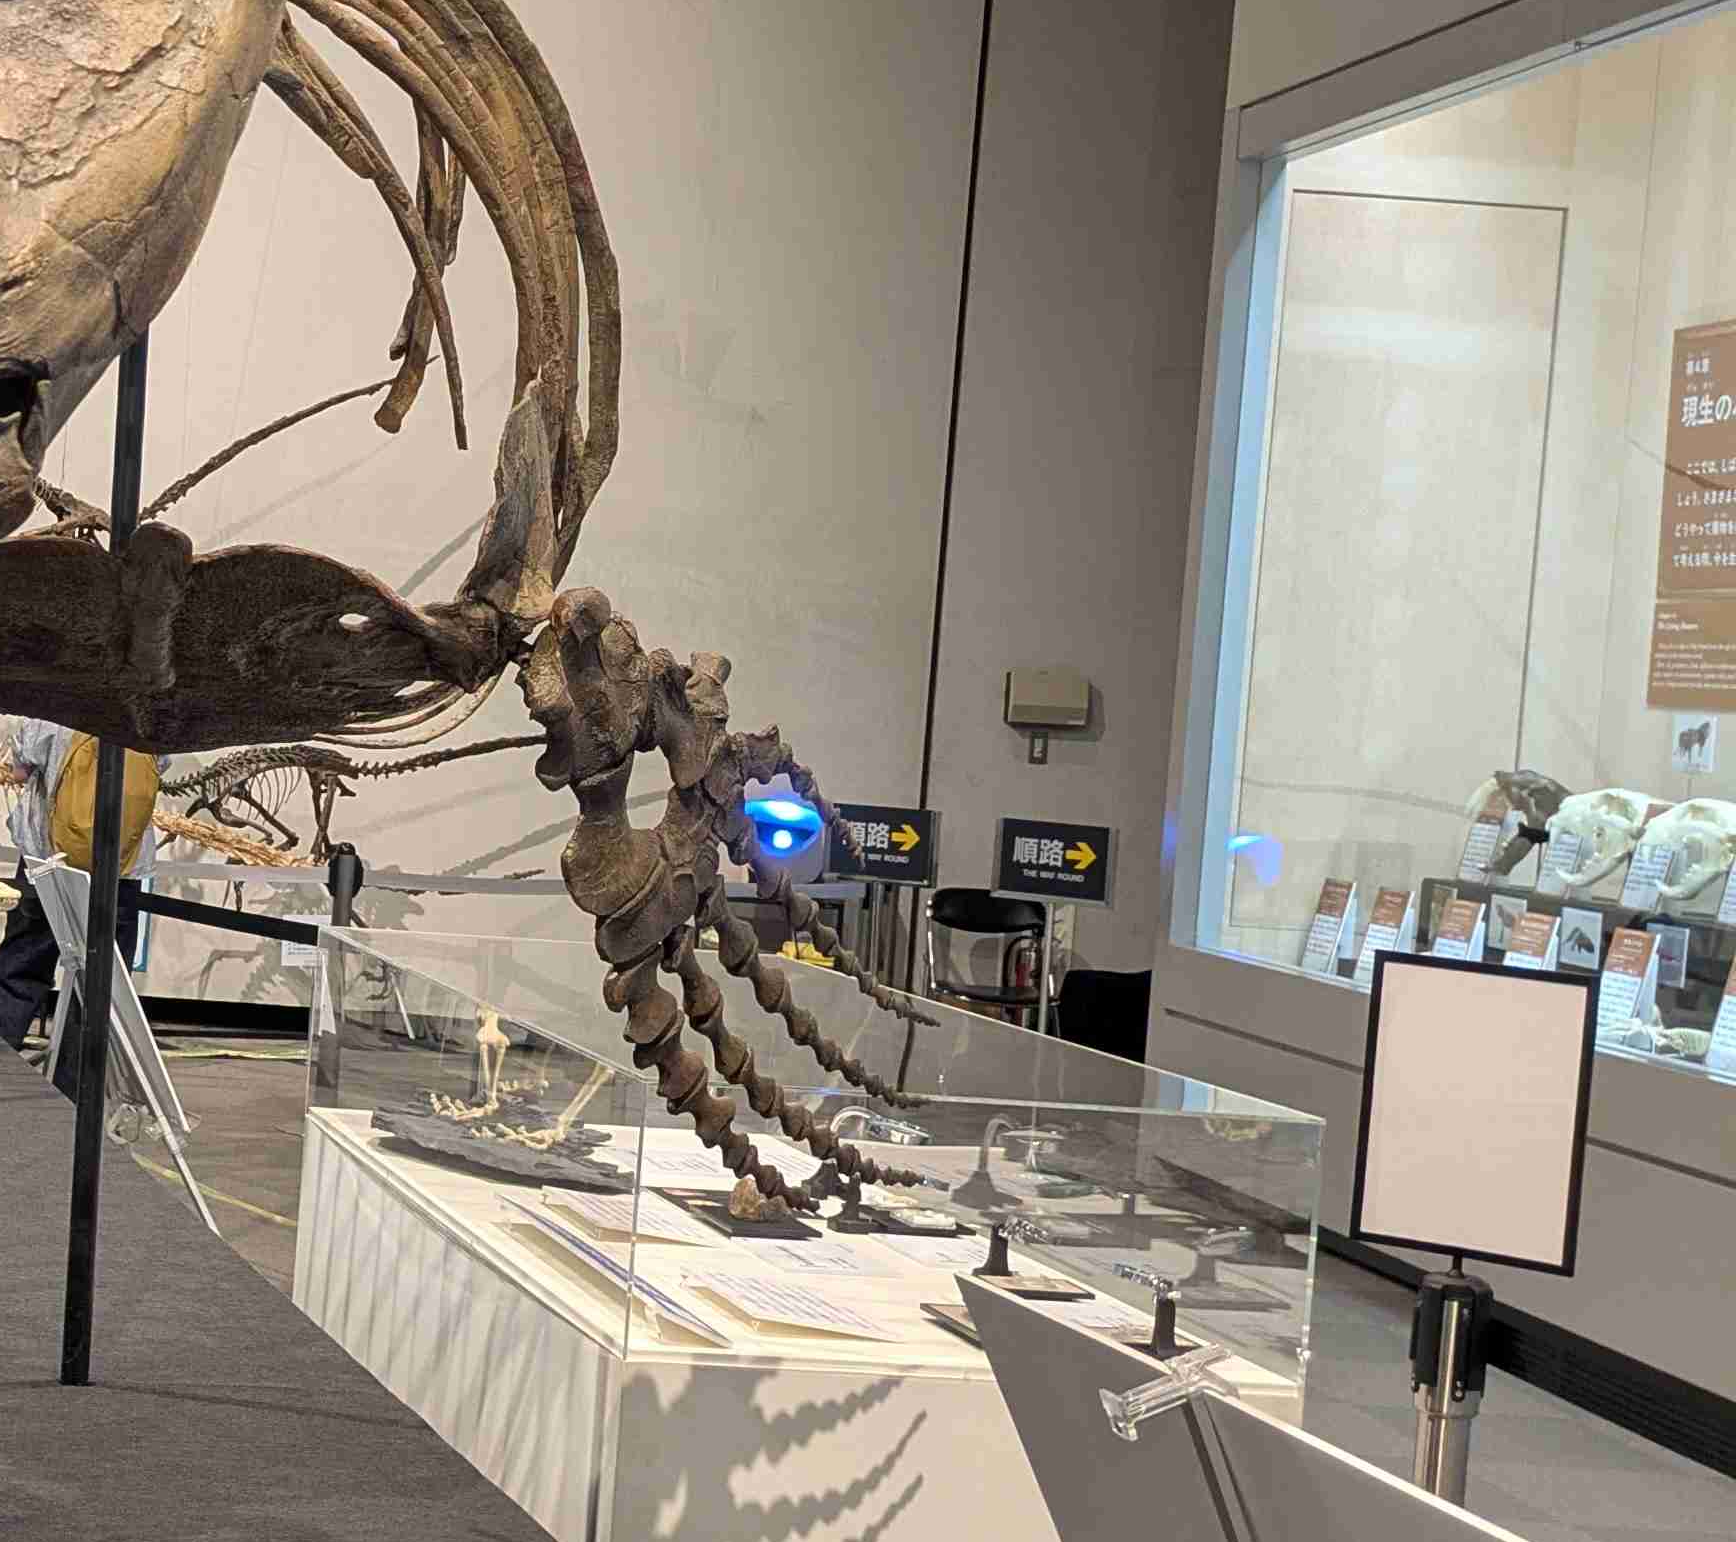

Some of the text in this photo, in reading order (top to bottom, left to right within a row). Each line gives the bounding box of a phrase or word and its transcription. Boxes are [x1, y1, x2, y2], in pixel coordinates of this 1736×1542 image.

[1681, 394, 1736, 426] 現生の
[1013, 836, 1065, 868] 順路
